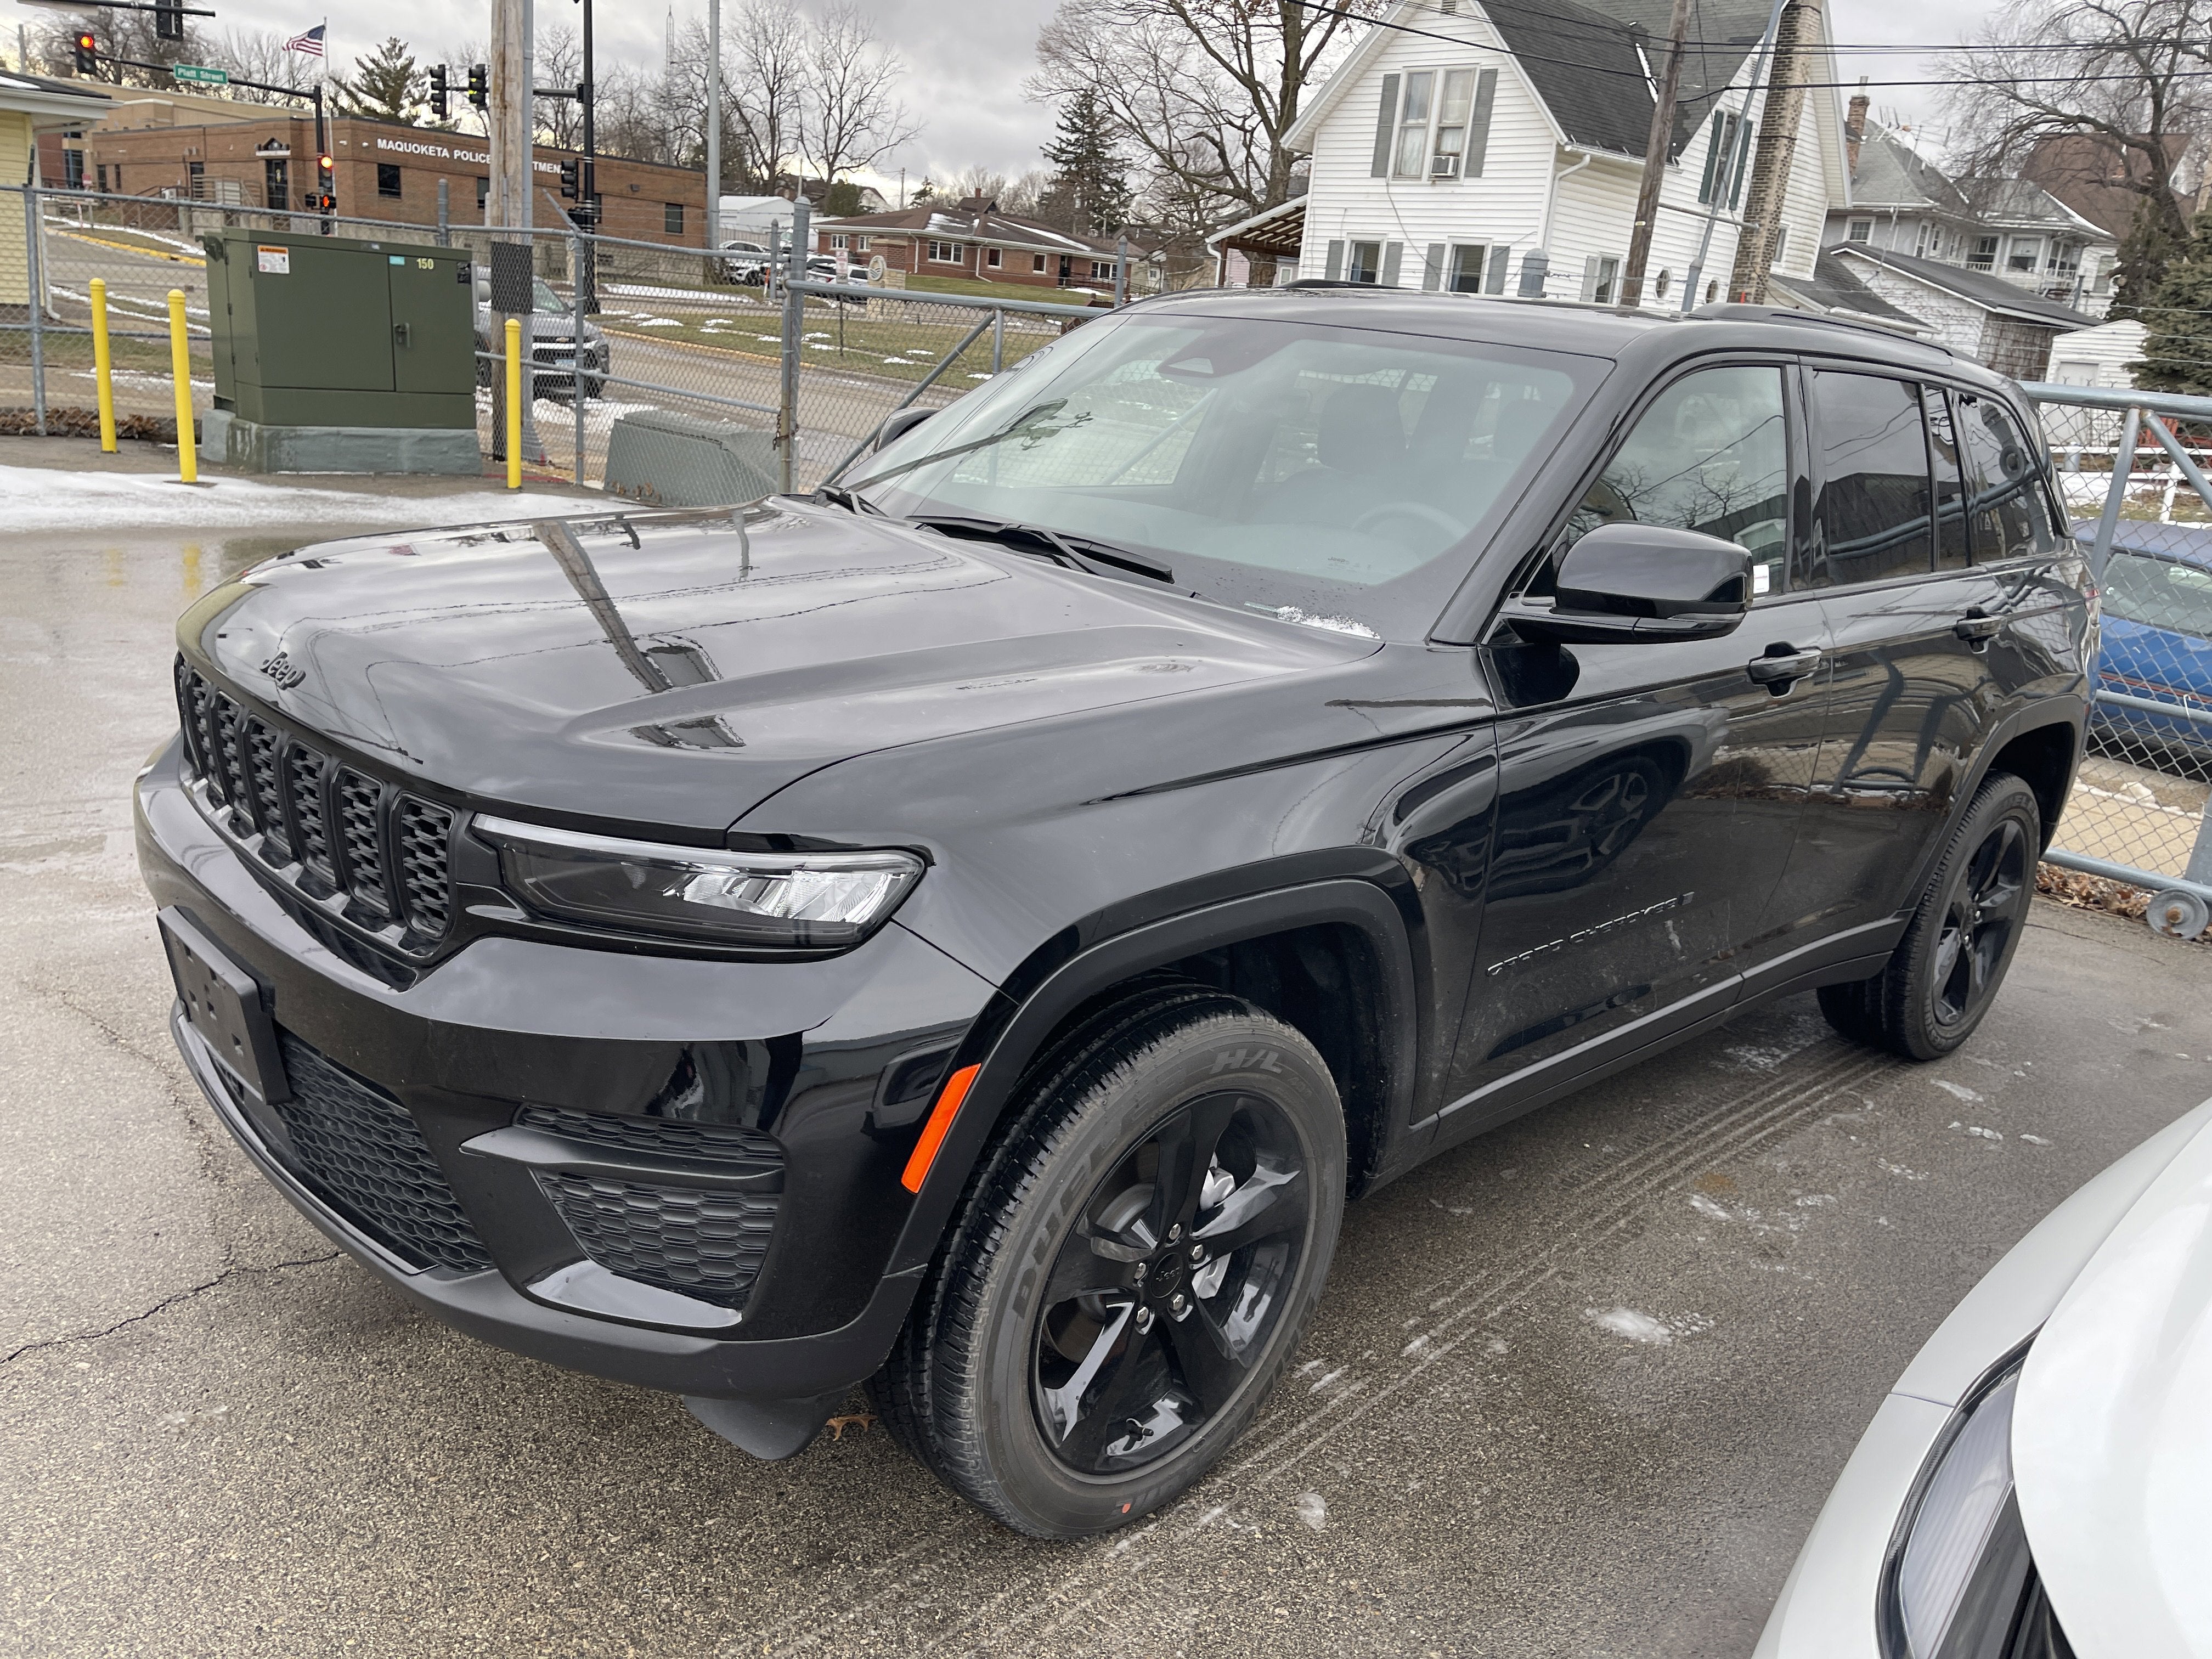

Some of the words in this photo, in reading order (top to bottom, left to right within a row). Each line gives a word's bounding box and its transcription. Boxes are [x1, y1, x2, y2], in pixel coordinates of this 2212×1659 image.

[200, 70, 224, 81] Street
[376, 138, 450, 159] MAQUOKETA
[453, 149, 492, 165] POLICE
[416, 258, 435, 270] 150
[259, 651, 306, 690] Jeep
[1012, 1069, 1187, 1318] DUELER
[1209, 1048, 1283, 1075] H/L
[1155, 1266, 1181, 1282] Jeep
